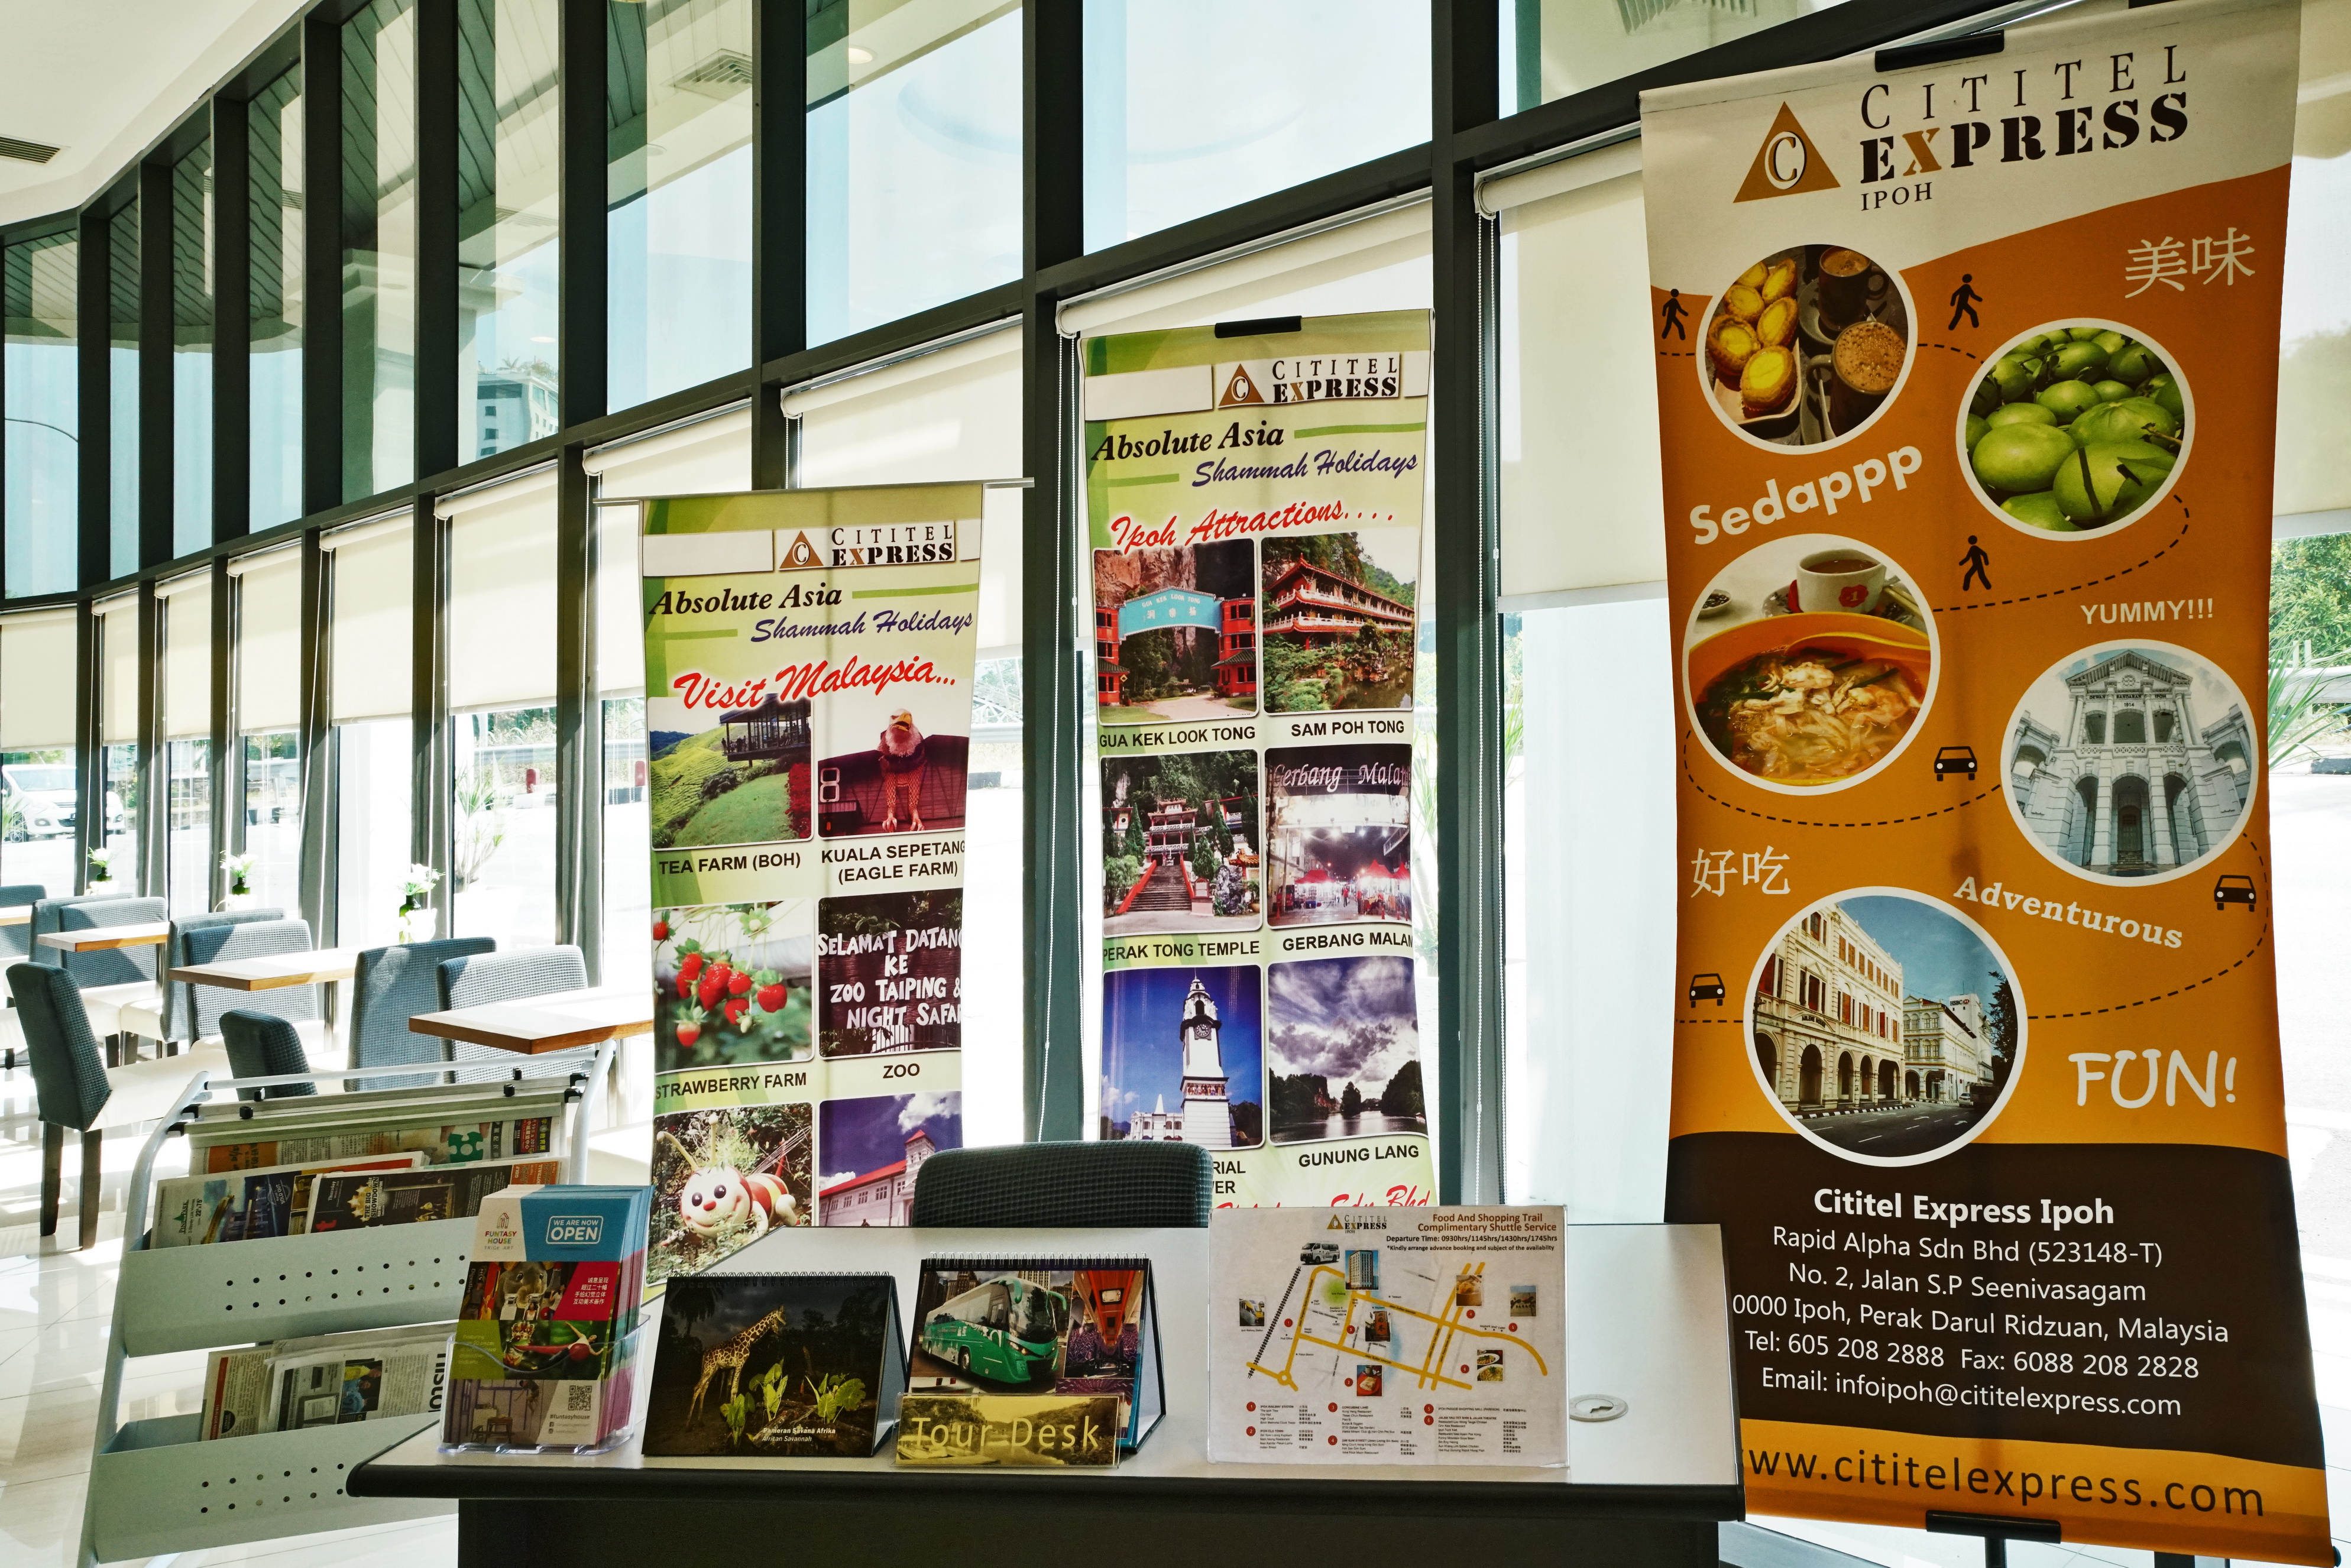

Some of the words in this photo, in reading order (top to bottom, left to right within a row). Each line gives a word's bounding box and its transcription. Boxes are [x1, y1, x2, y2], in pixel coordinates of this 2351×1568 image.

[1861, 44, 2188, 129] CITITEL
[1860, 90, 2189, 184] EXPRESS
[1861, 182, 1933, 210] IPOH
[2125, 228, 2255, 299] 美味
[1272, 357, 1397, 380] CITITEL
[1272, 377, 1397, 404] EXPRESS
[1092, 429, 1212, 461] Absolute
[1218, 420, 1284, 449] Asia
[1192, 452, 1308, 487] Shammah
[1314, 449, 1418, 480] Holidays
[1689, 445, 1923, 545] Sedappp
[832, 525, 952, 546] CITITEL
[1111, 515, 1178, 555] Ipoh
[833, 543, 953, 566] EXPRESS
[649, 588, 772, 615] Absolute
[779, 582, 842, 609] Asia
[2081, 598, 2214, 625] YUMMY!!!
[750, 611, 866, 642] Shammah
[873, 610, 973, 637] Holidays
[673, 672, 767, 710] Visit
[776, 655, 955, 702] Malaysia...
[1099, 733, 1128, 747] GUA
[1132, 731, 1164, 747] KEK
[1168, 729, 1207, 744] LOOK
[1212, 726, 1256, 741] TONG
[1291, 723, 1326, 737] SAM
[1332, 721, 1364, 735] POH
[1368, 720, 1404, 733] TONG
[660, 859, 693, 874] TEA
[698, 856, 747, 872] FARM
[753, 852, 801, 872] (BOH)
[822, 847, 882, 863] KUALA
[886, 840, 965, 858] SEPETANG
[838, 865, 903, 885] (EAGLE
[909, 861, 957, 877] FARM)
[1690, 846, 1790, 898] 好吃
[1954, 875, 2184, 950] Adventurous
[819, 930, 896, 956] SELAMAT
[1103, 945, 1148, 961] PERAK
[1153, 943, 1193, 958] TONG
[1197, 940, 1260, 956] TEMPLE
[1283, 933, 1364, 951] GERBANG
[885, 954, 908, 977] KE
[830, 982, 865, 1003] ZOO
[876, 977, 947, 1002] TAIPING
[953, 977, 961, 998] &
[847, 1006, 907, 1029] NIGHT
[883, 1064, 920, 1079] ZOO
[2070, 1050, 2237, 1109] FUN!
[655, 1075, 760, 1100] STRAWBERRY
[765, 1072, 807, 1088] FARM
[1299, 1148, 1369, 1167] GUNUNG
[1375, 1145, 1419, 1159] LANG
[1478, 1213, 1520, 1224] Shopping
[1522, 1213, 1542, 1222] Trail
[1814, 1188, 1902, 1219] Cititel
[1913, 1194, 2031, 1228] Express
[2042, 1198, 2114, 1232] Ipoh
[550, 1227, 599, 1240] OPEN
[1418, 1223, 1487, 1233] Complimentary
[1489, 1223, 1521, 1231] Shuttle
[1524, 1223, 1556, 1231] Service
[1773, 1227, 1835, 1255] Rapid
[1844, 1232, 1910, 1258] Alpha
[1919, 1236, 1964, 1261] Sdn
[1973, 1238, 2019, 1263] Bhd
[2029, 1241, 2162, 1267] (523148-T)
[1789, 1264, 1828, 1286] No.
[1835, 1266, 1854, 1292] 2,
[1862, 1269, 1919, 1294] Jalan
[1928, 1274, 1962, 1296] S.P
[1971, 1277, 2146, 1308] Seenivasagam
[1794, 1299, 1851, 1327] Ipoh,
[1860, 1304, 1922, 1330] Perak
[1932, 1309, 1994, 1334] Darul
[2005, 1314, 2109, 1342] Ridzuan,
[2119, 1317, 2229, 1347] Malaysia
[1745, 1330, 1780, 1354] Tel:
[1788, 1334, 1829, 1357] 605
[1837, 1337, 1879, 1360] 208
[1887, 1342, 1944, 1367] 2888
[1961, 1348, 2005, 1371] Fax:
[2014, 1350, 2074, 1374] 6088
[2083, 1353, 2128, 1376] 208
[2137, 1355, 2198, 1378] 2828
[1763, 1367, 1828, 1392] Email:
[1835, 1371, 2181, 1416] infoipoh@cititelexpress.com
[911, 1417, 993, 1447] Tour
[1011, 1415, 1099, 1447] Desk
[1741, 1447, 2263, 1517] ww.cititelexpress.com
